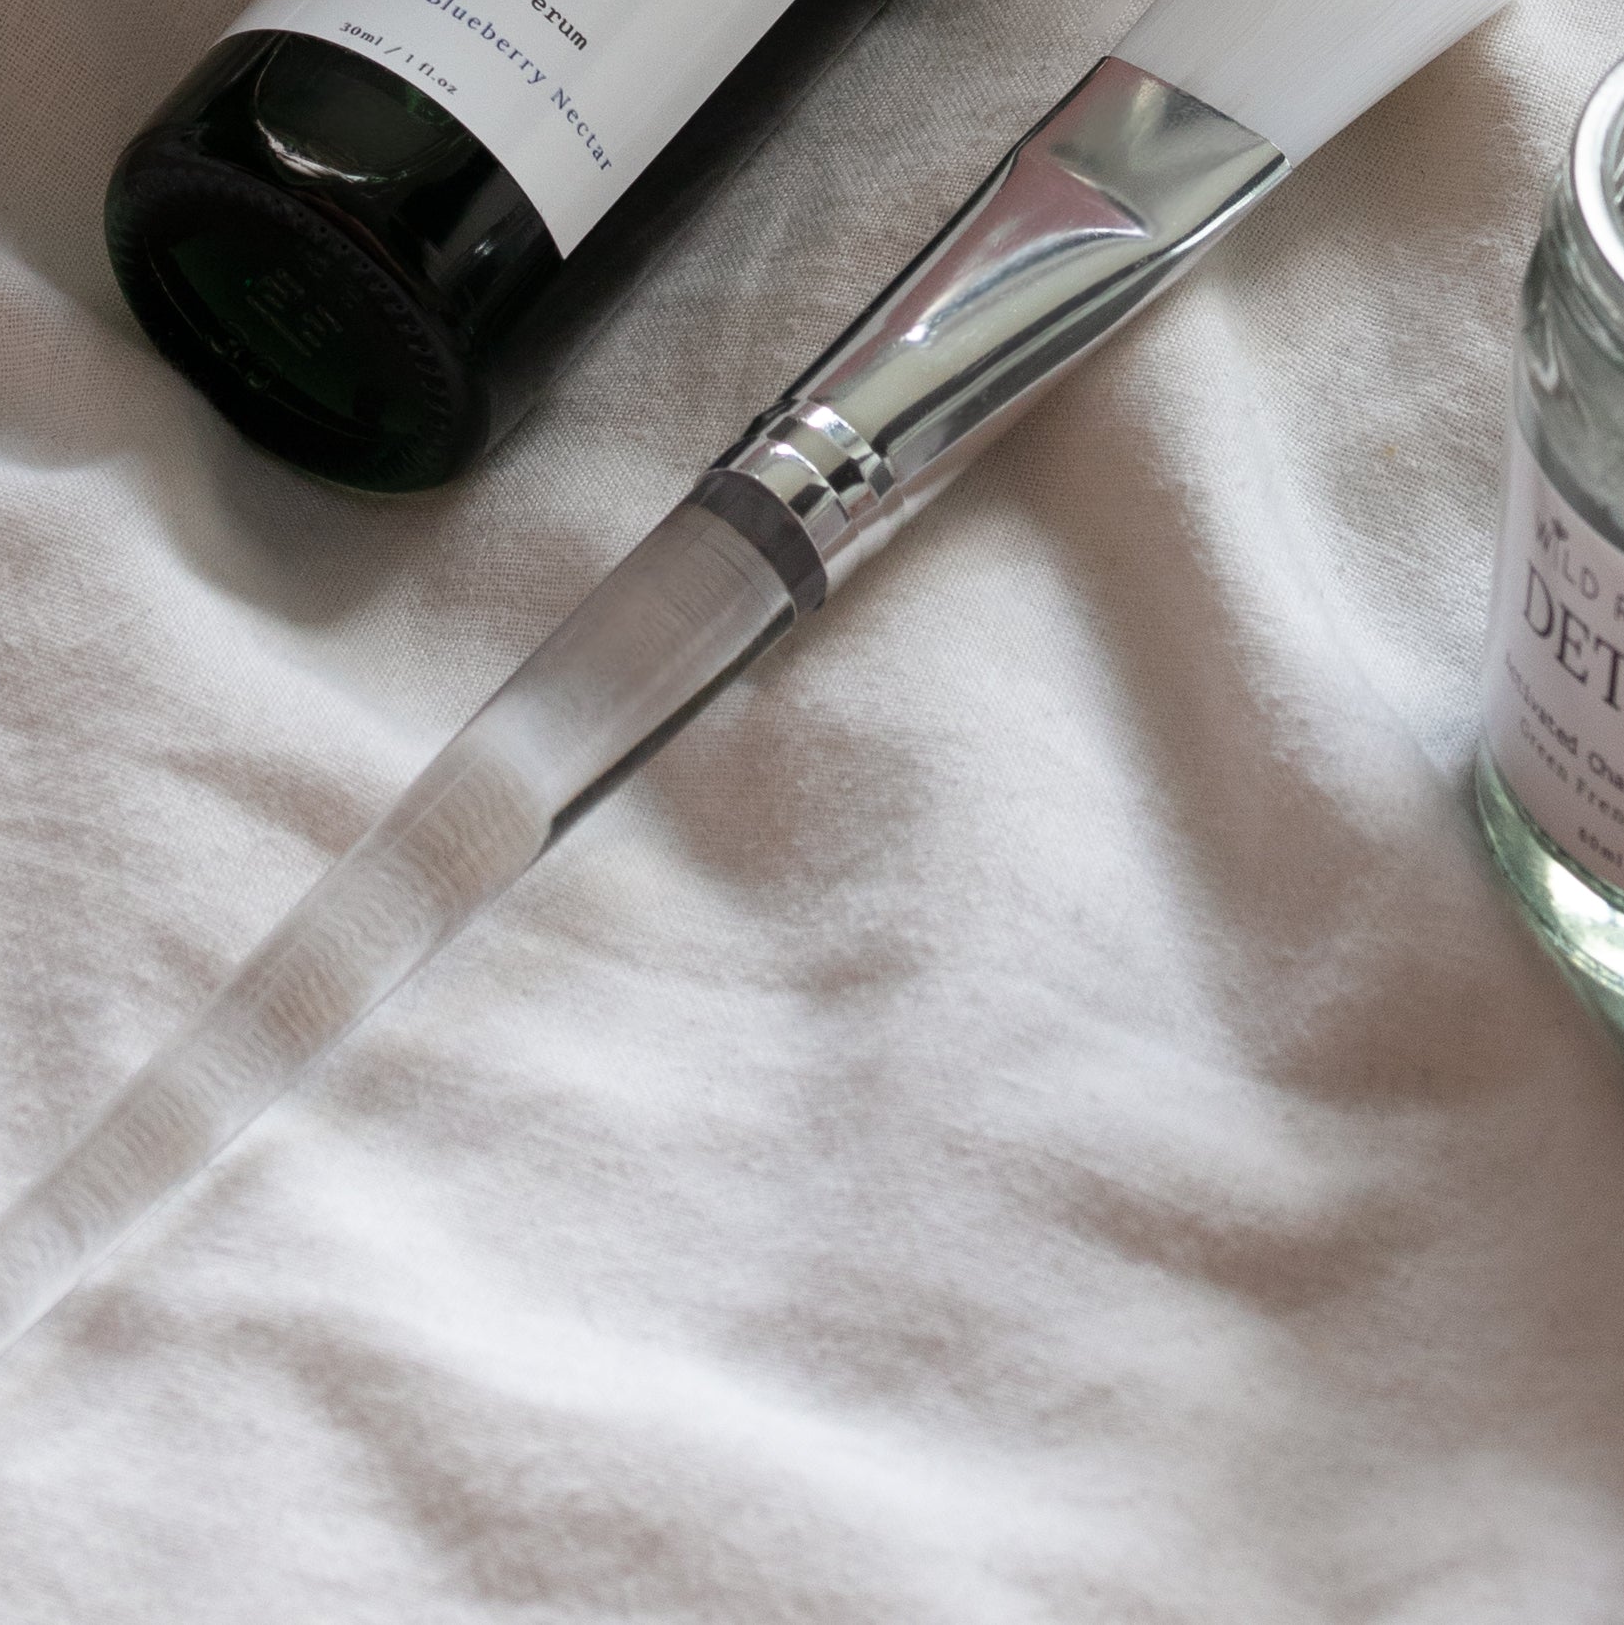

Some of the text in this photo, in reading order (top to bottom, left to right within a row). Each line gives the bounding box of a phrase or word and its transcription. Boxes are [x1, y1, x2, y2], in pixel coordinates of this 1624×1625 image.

[339, 22, 384, 46] 30ml
[384, 46, 402, 55] /
[405, 54, 415, 63] 1
[551, 88, 612, 170] Nectar
